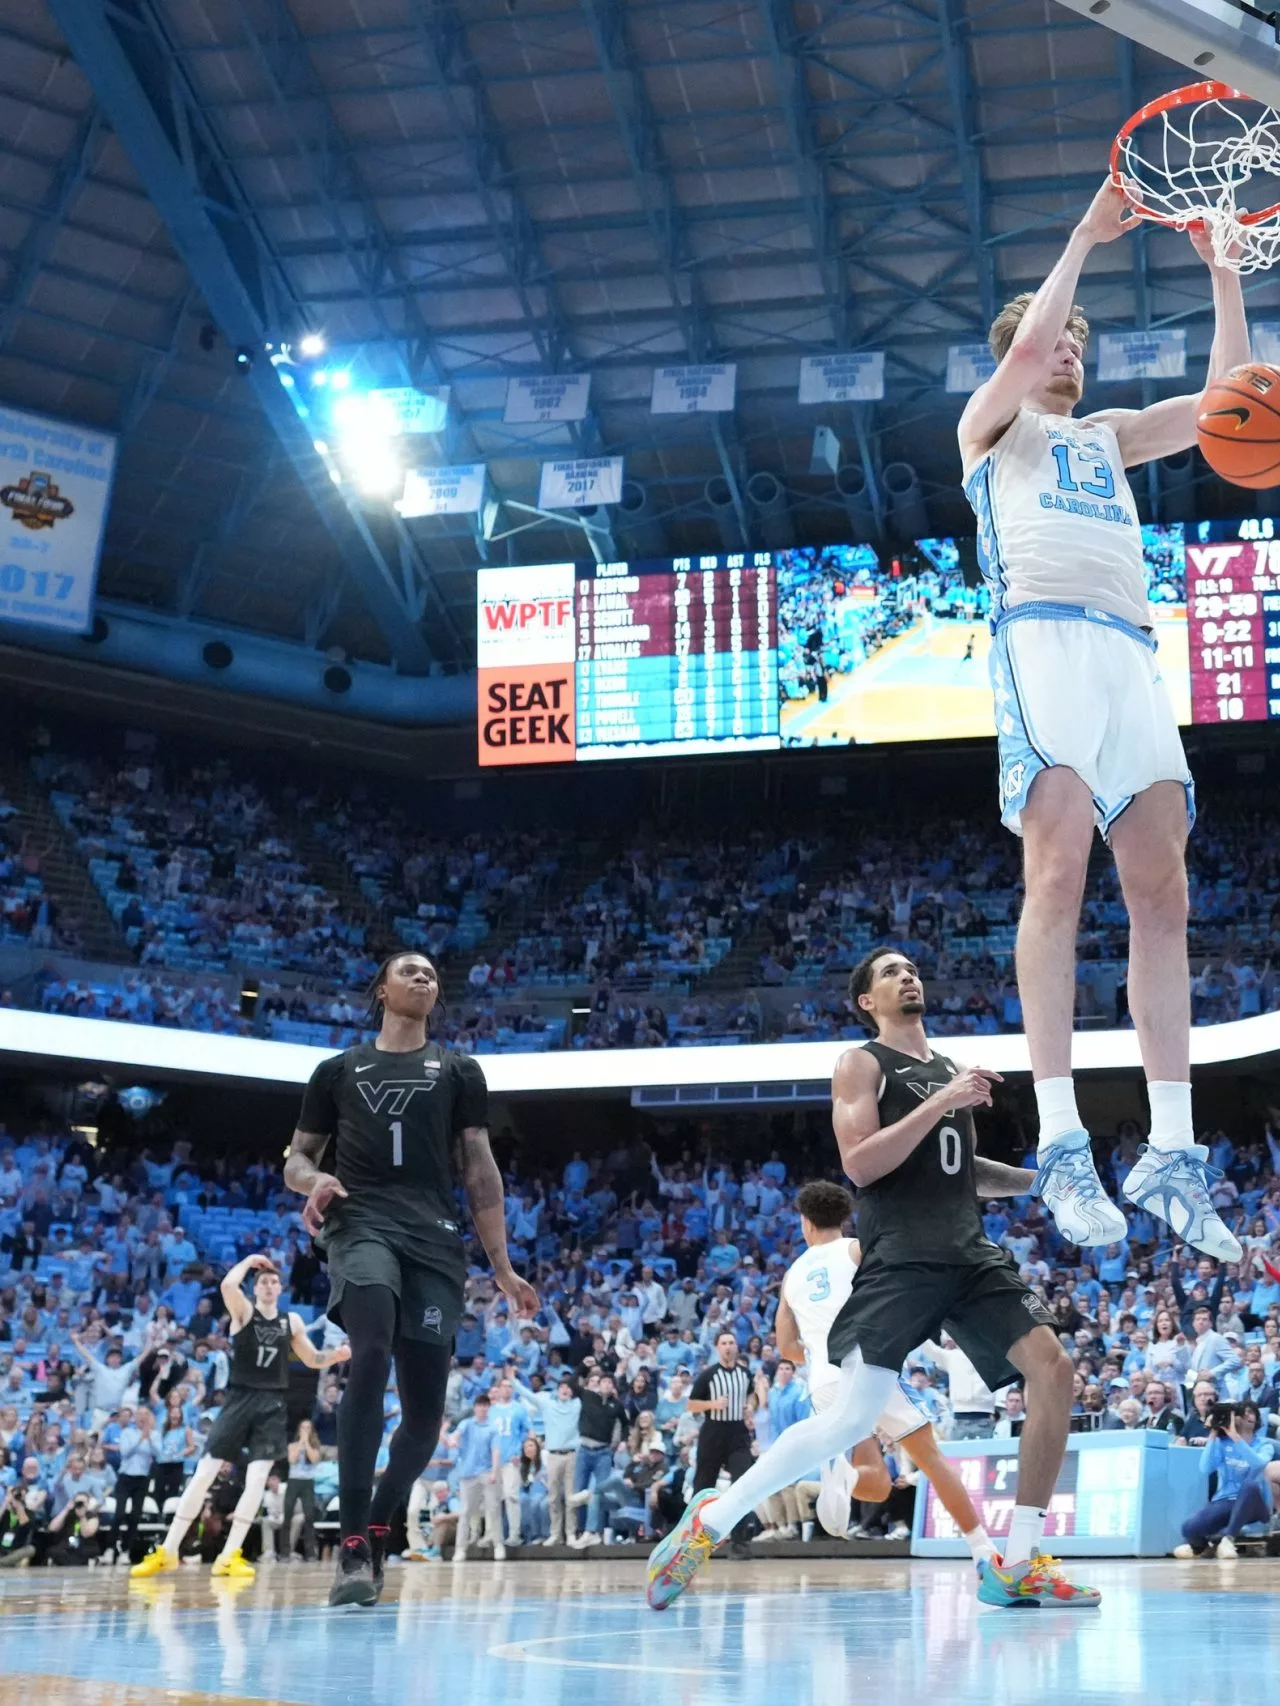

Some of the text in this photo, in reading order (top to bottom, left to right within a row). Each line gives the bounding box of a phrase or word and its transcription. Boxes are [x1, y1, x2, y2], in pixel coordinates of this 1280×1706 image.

[567, 479, 595, 494] 2017
[1051, 444, 1116, 500] 13
[1039, 492, 1133, 527] CAROLINA
[673, 558, 690, 571] PTS
[727, 554, 744, 568] AST
[1188, 545, 1243, 576] VT
[484, 600, 571, 631] WPTF
[675, 621, 690, 639] 14
[578, 645, 591, 660] 17
[1201, 645, 1254, 670] 11-11
[488, 678, 568, 713] SEAT
[1216, 672, 1241, 695] 21
[483, 714, 571, 748] GEEK
[356, 1080, 437, 1115] VT
[388, 1121, 403, 1167] 1
[939, 1126, 962, 1175] 0
[806, 1266, 831, 1302] 3
[256, 1346, 278, 1368] 17
